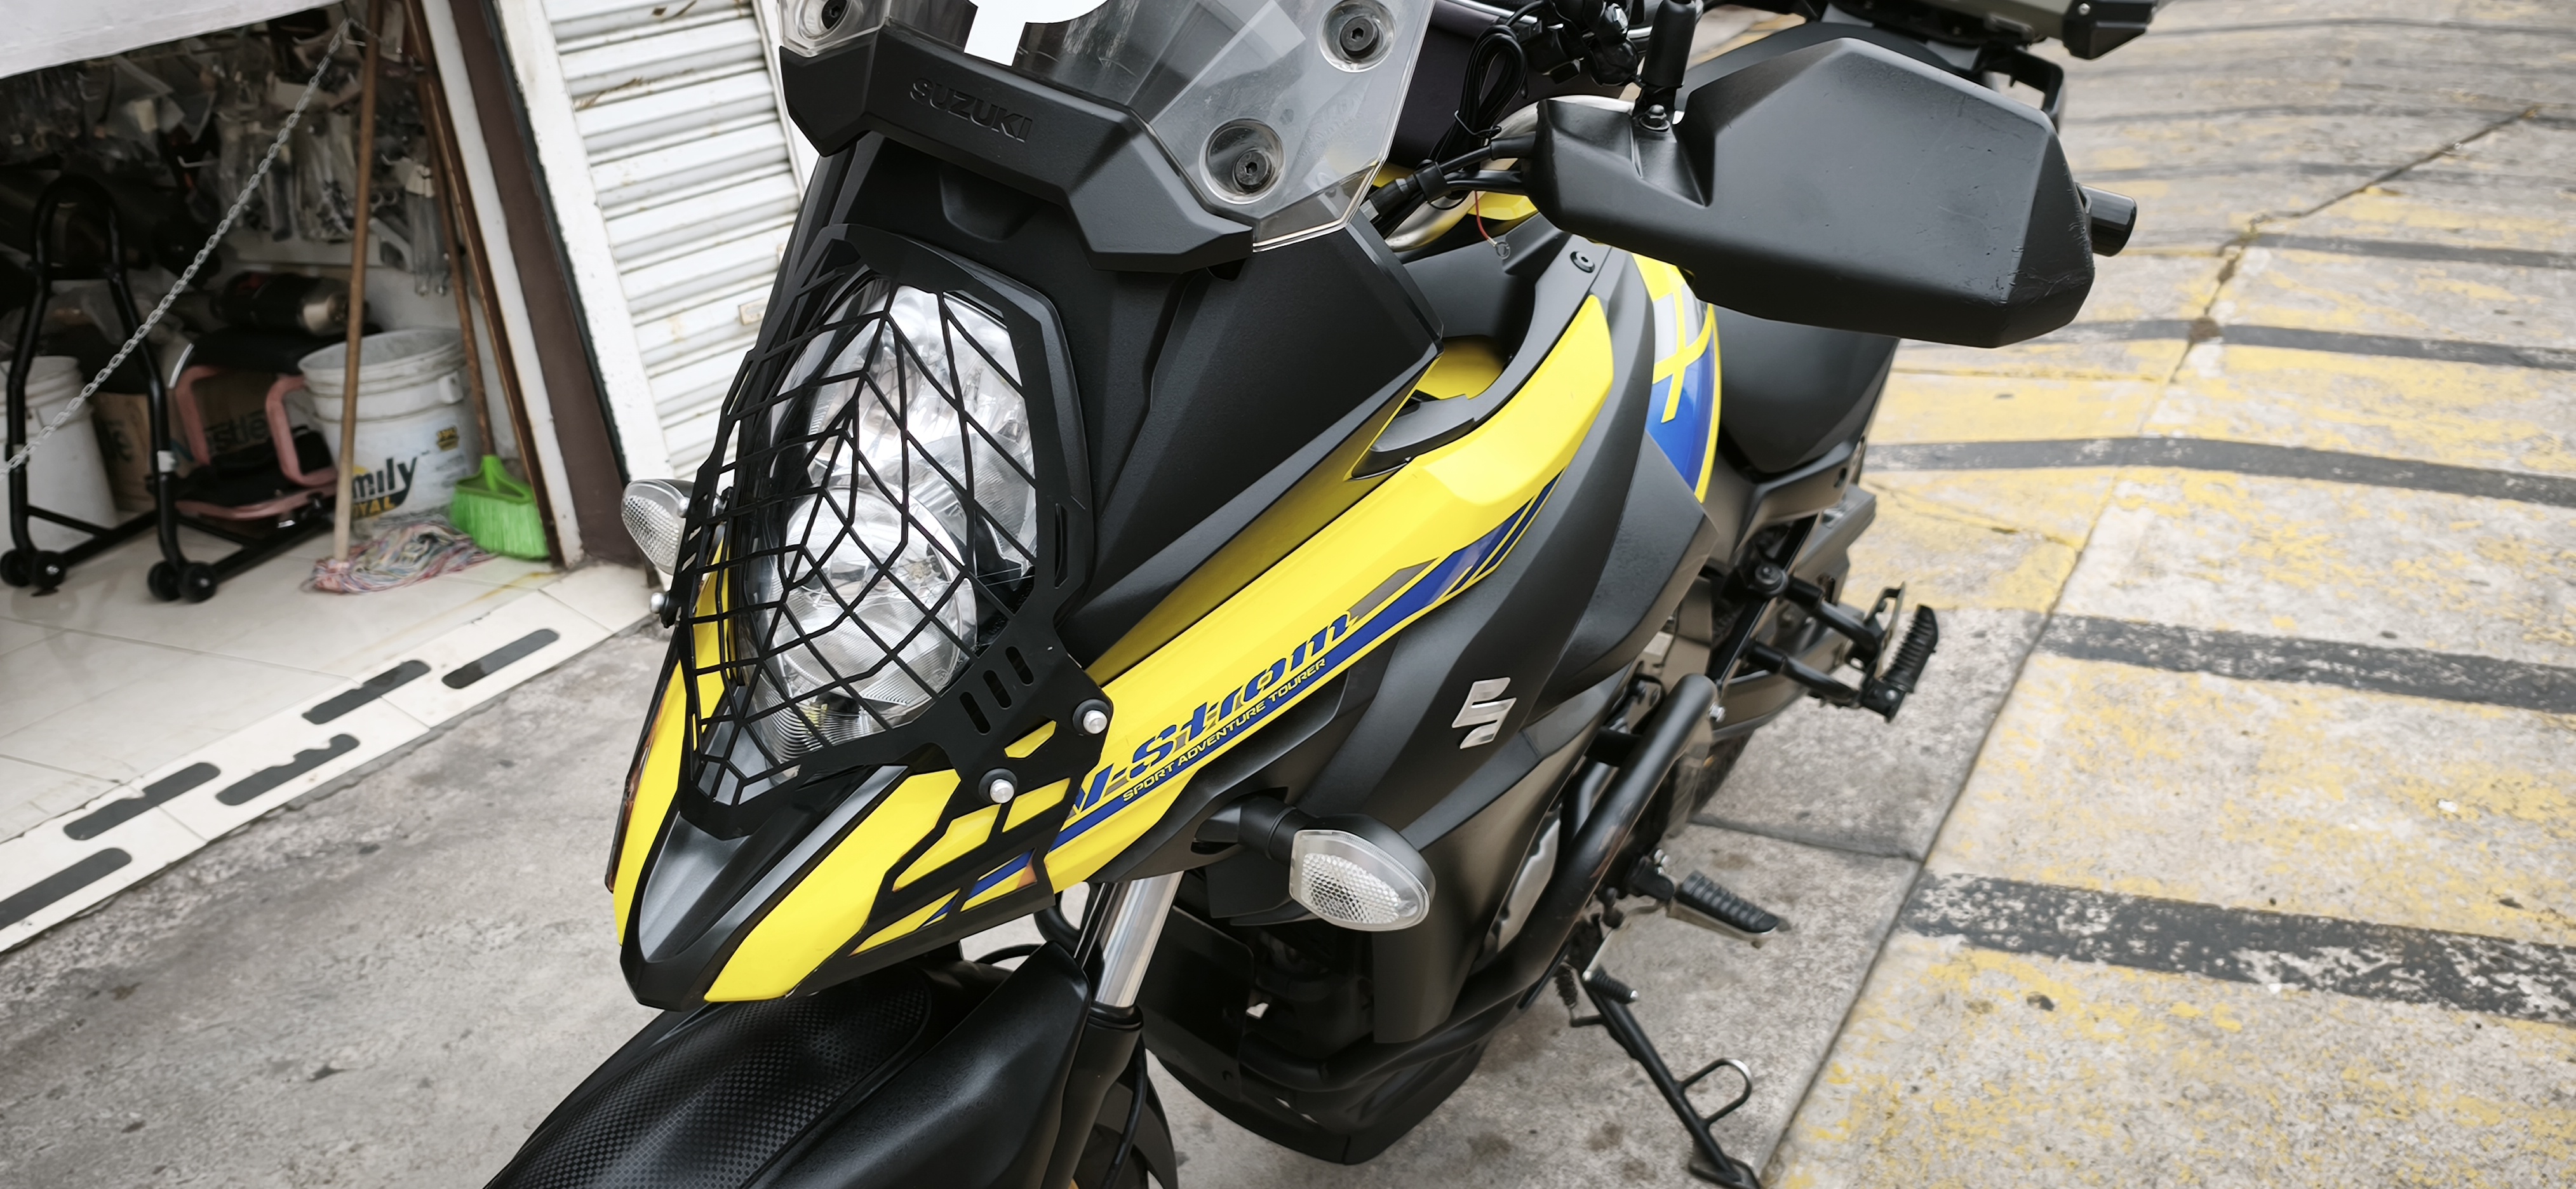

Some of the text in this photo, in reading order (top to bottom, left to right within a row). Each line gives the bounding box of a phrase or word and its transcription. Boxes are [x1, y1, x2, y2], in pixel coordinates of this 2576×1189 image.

[910, 77, 1033, 144] SUZUKI
[1122, 658, 1326, 802] SPORT ADVENTURE TOURER
